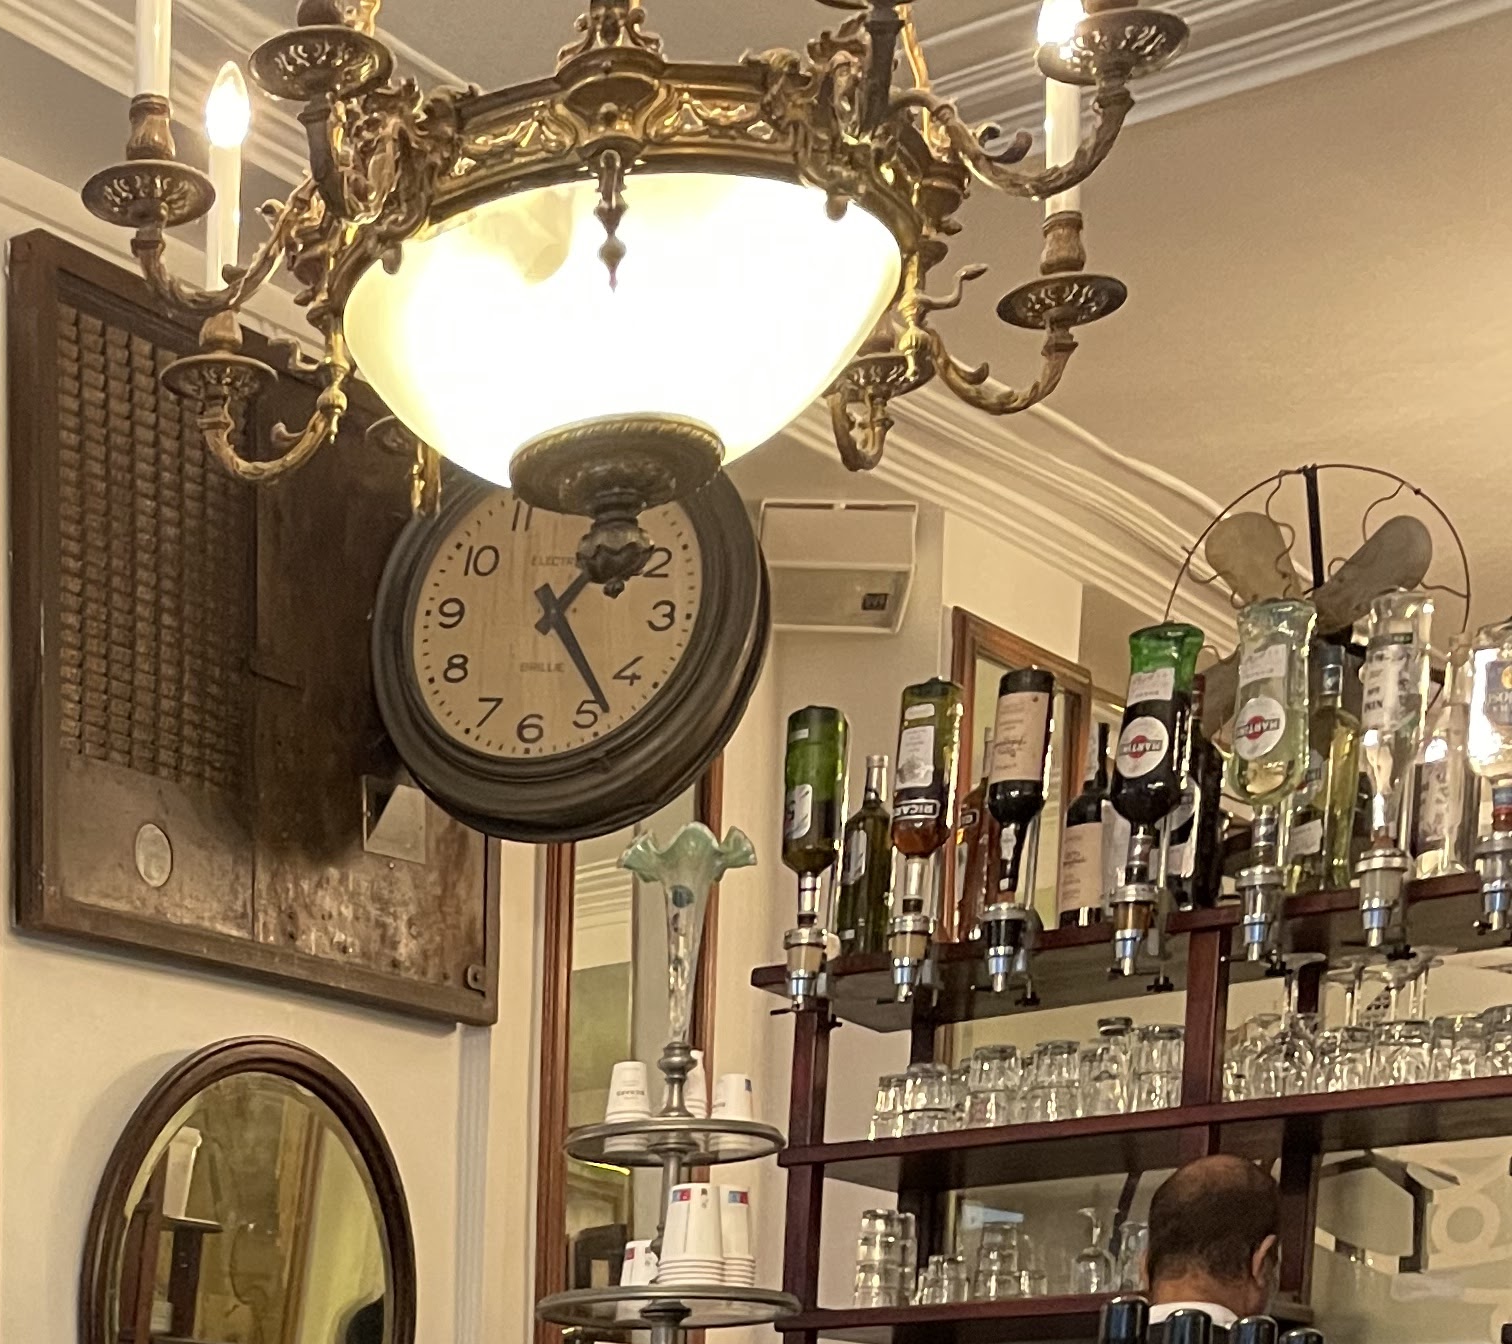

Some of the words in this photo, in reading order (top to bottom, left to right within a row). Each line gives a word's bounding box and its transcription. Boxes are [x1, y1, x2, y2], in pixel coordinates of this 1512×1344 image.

[463, 545, 500, 577] 10
[643, 547, 673, 578] 2
[438, 597, 465, 630] 9
[646, 600, 676, 632] 3
[443, 653, 469, 684] 8
[613, 656, 643, 687] 4
[478, 697, 504, 728] 7
[573, 699, 600, 730] 5
[1236, 720, 1279, 736] MARTI
[516, 713, 544, 744] 6
[892, 803, 934, 817] RICAR
